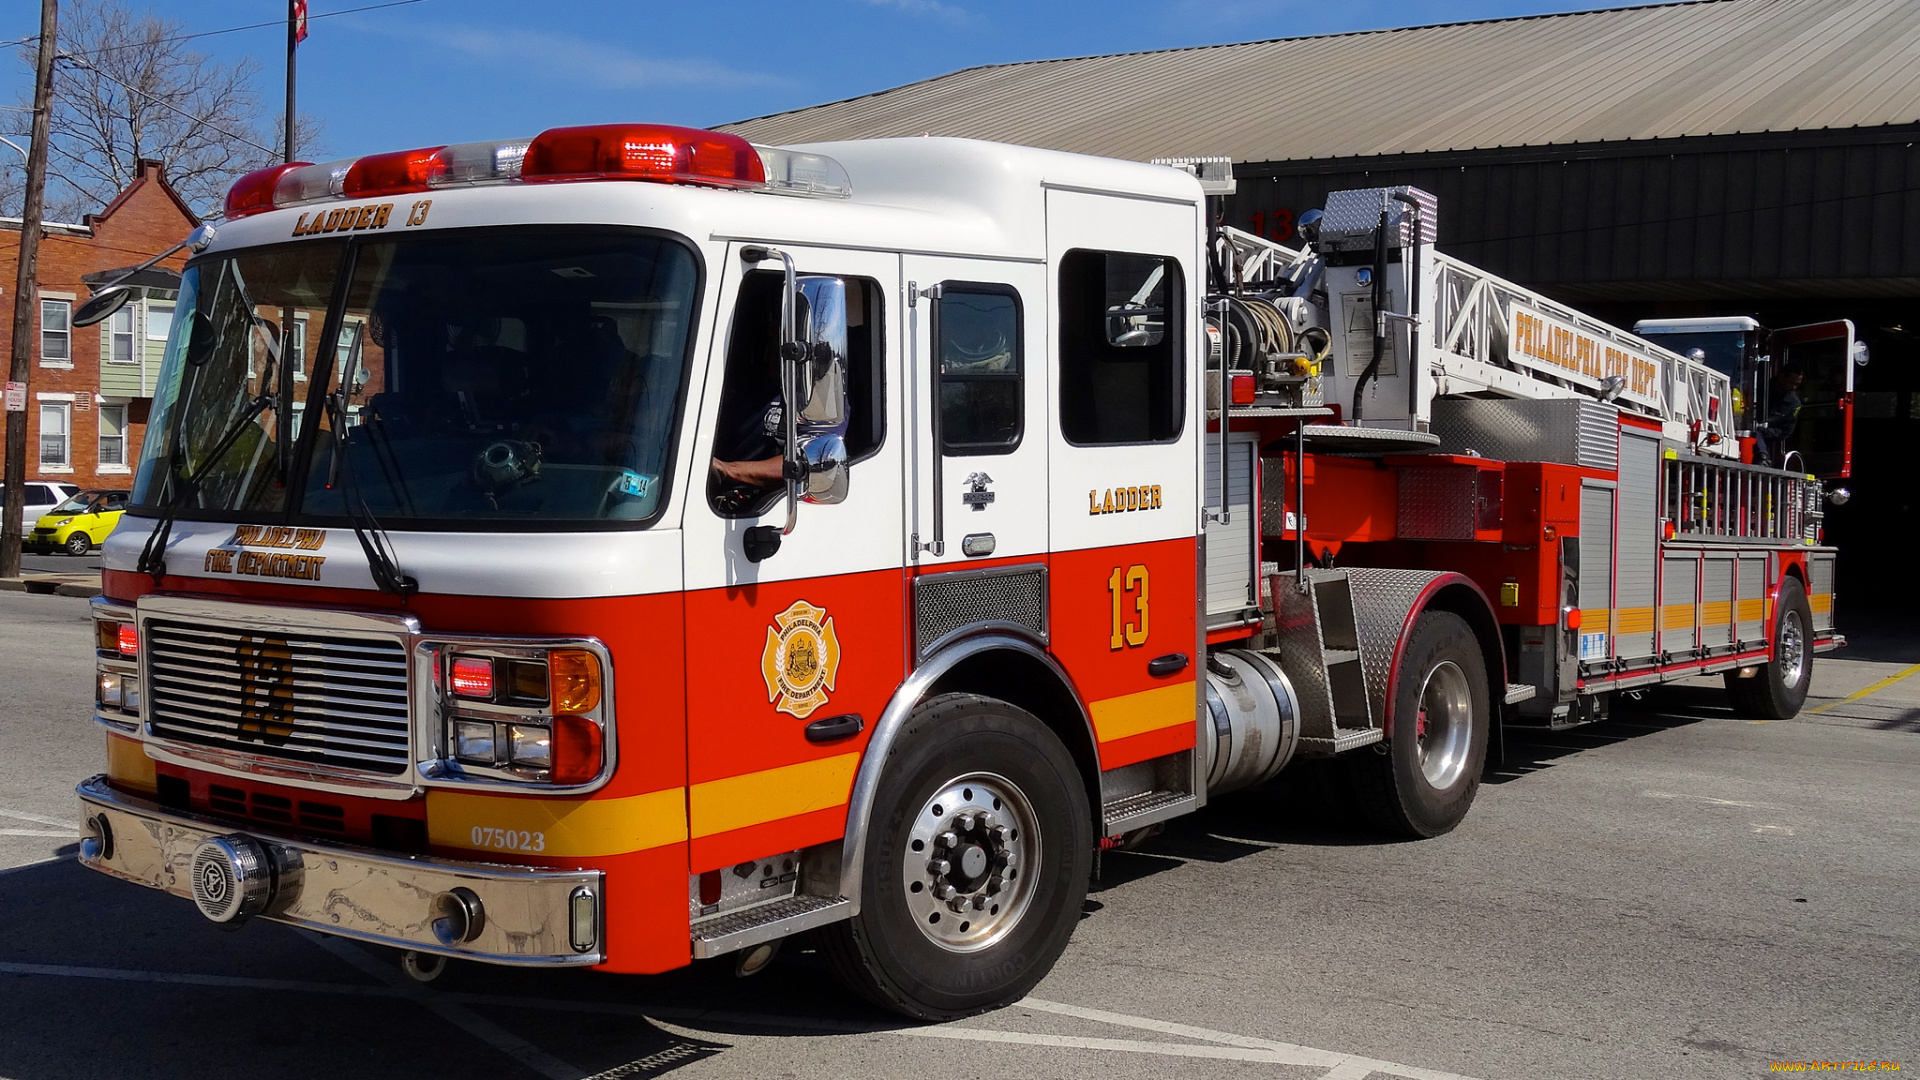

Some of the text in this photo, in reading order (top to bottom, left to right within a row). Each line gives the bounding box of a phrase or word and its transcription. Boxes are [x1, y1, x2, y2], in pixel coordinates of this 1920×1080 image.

[291, 200, 432, 237] LADDER 13
[1249, 208, 1293, 242] 13
[1514, 311, 1602, 380] PHILADELPHIA
[1631, 356, 1658, 400] DEPT.
[1089, 484, 1163, 515] LADDER
[228, 525, 327, 550] PHILADELPHIA
[204, 549, 327, 581] FIRE DEPARTMENT
[1108, 564, 1149, 652] 13
[780, 619, 823, 641] PHILADELPHIA
[777, 670, 826, 699] FIRE DEPARTMENT
[471, 825, 546, 852] 075023
